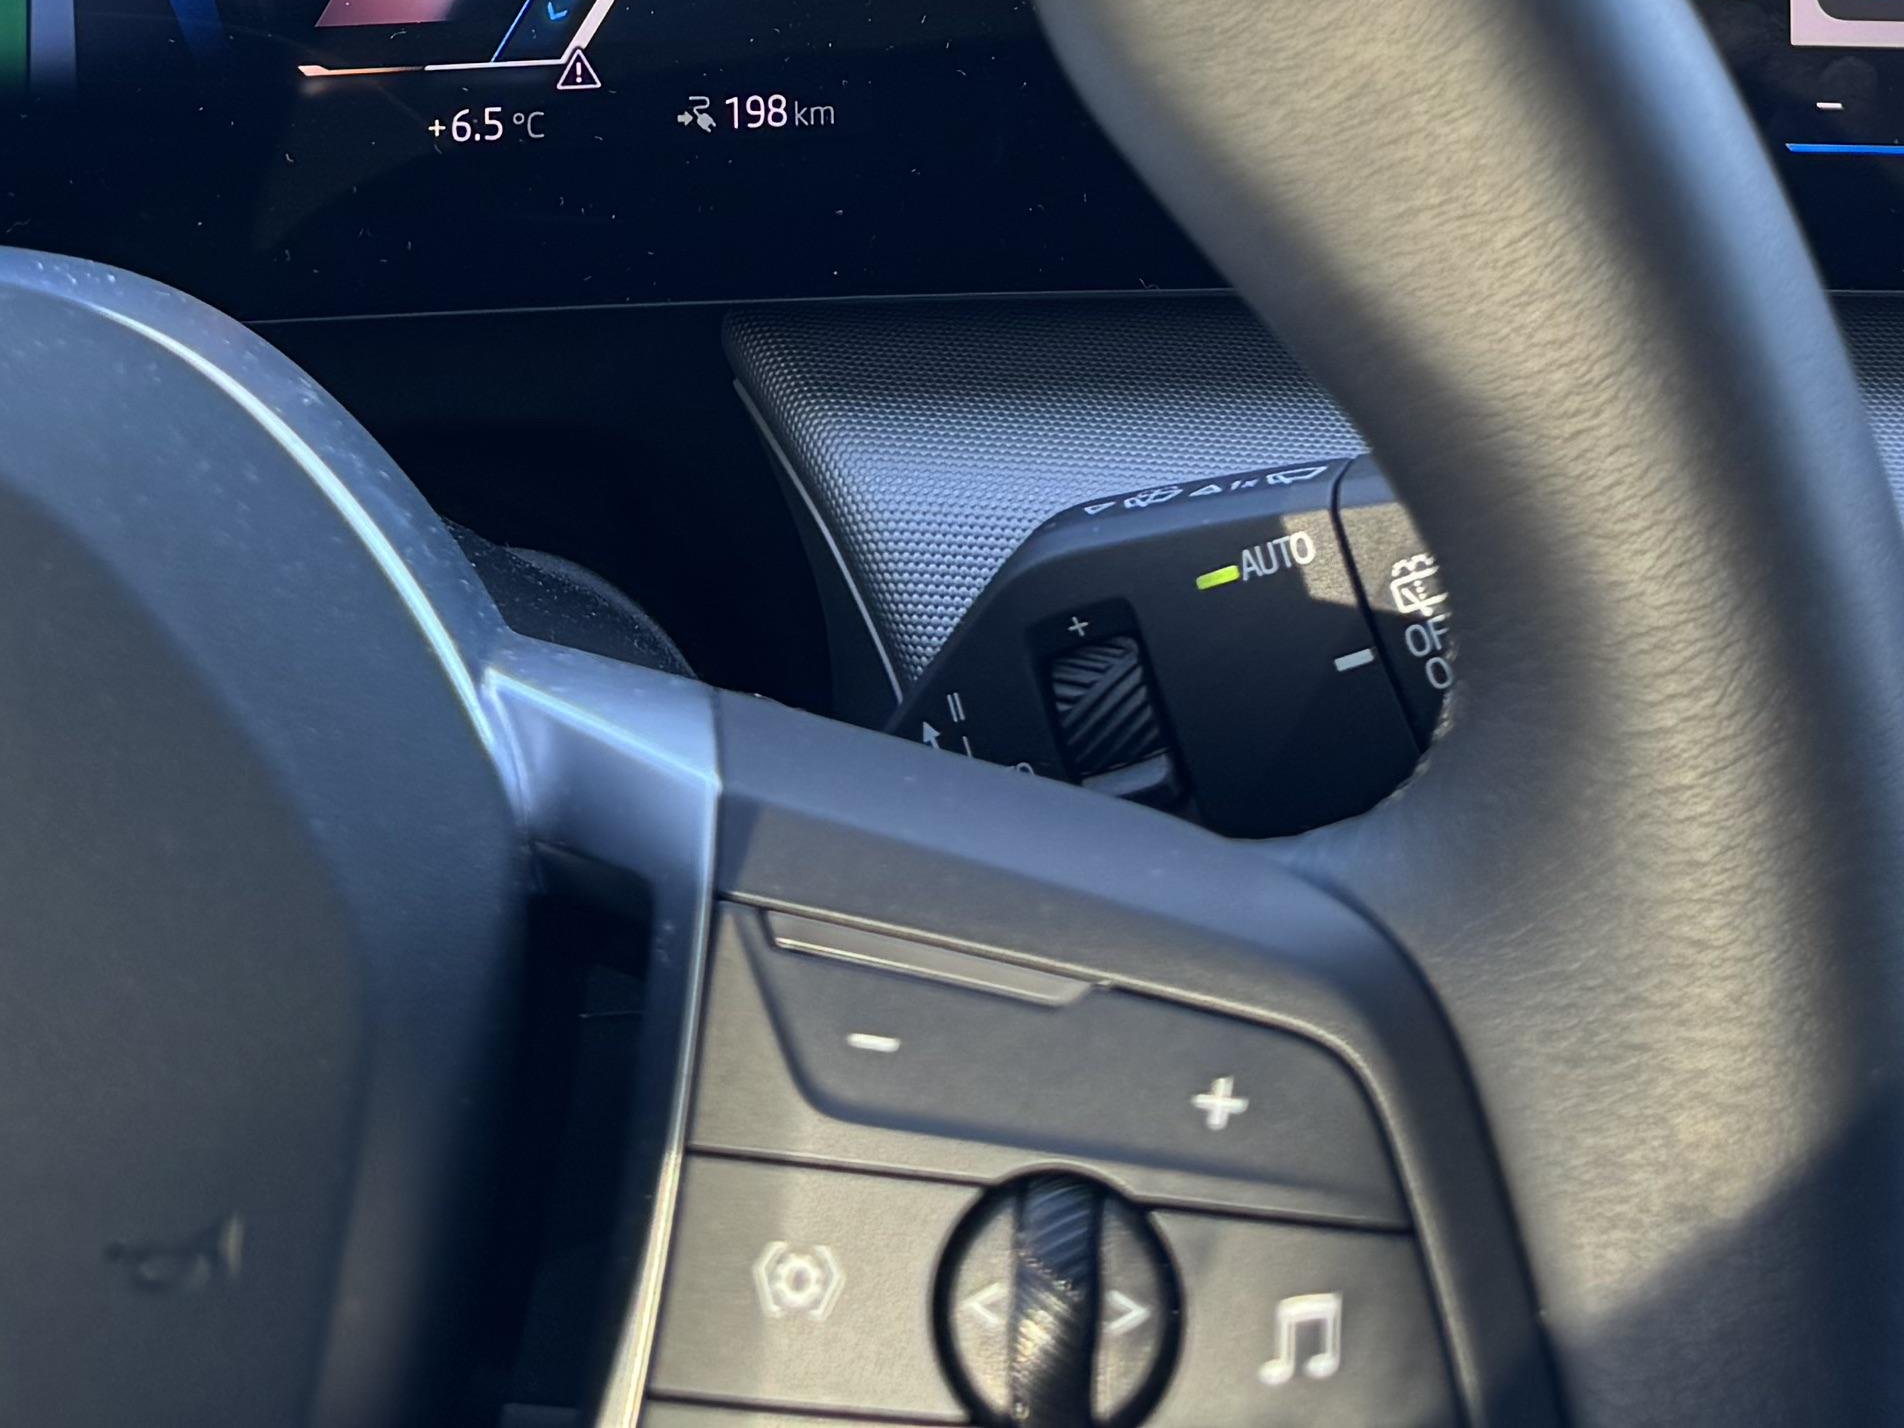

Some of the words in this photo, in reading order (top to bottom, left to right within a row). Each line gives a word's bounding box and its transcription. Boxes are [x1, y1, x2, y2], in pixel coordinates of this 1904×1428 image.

[428, 109, 503, 141] +6.5
[513, 111, 545, 138] °C
[724, 97, 787, 127] 198
[794, 100, 834, 127] km
[1240, 532, 1316, 581] AUTO
